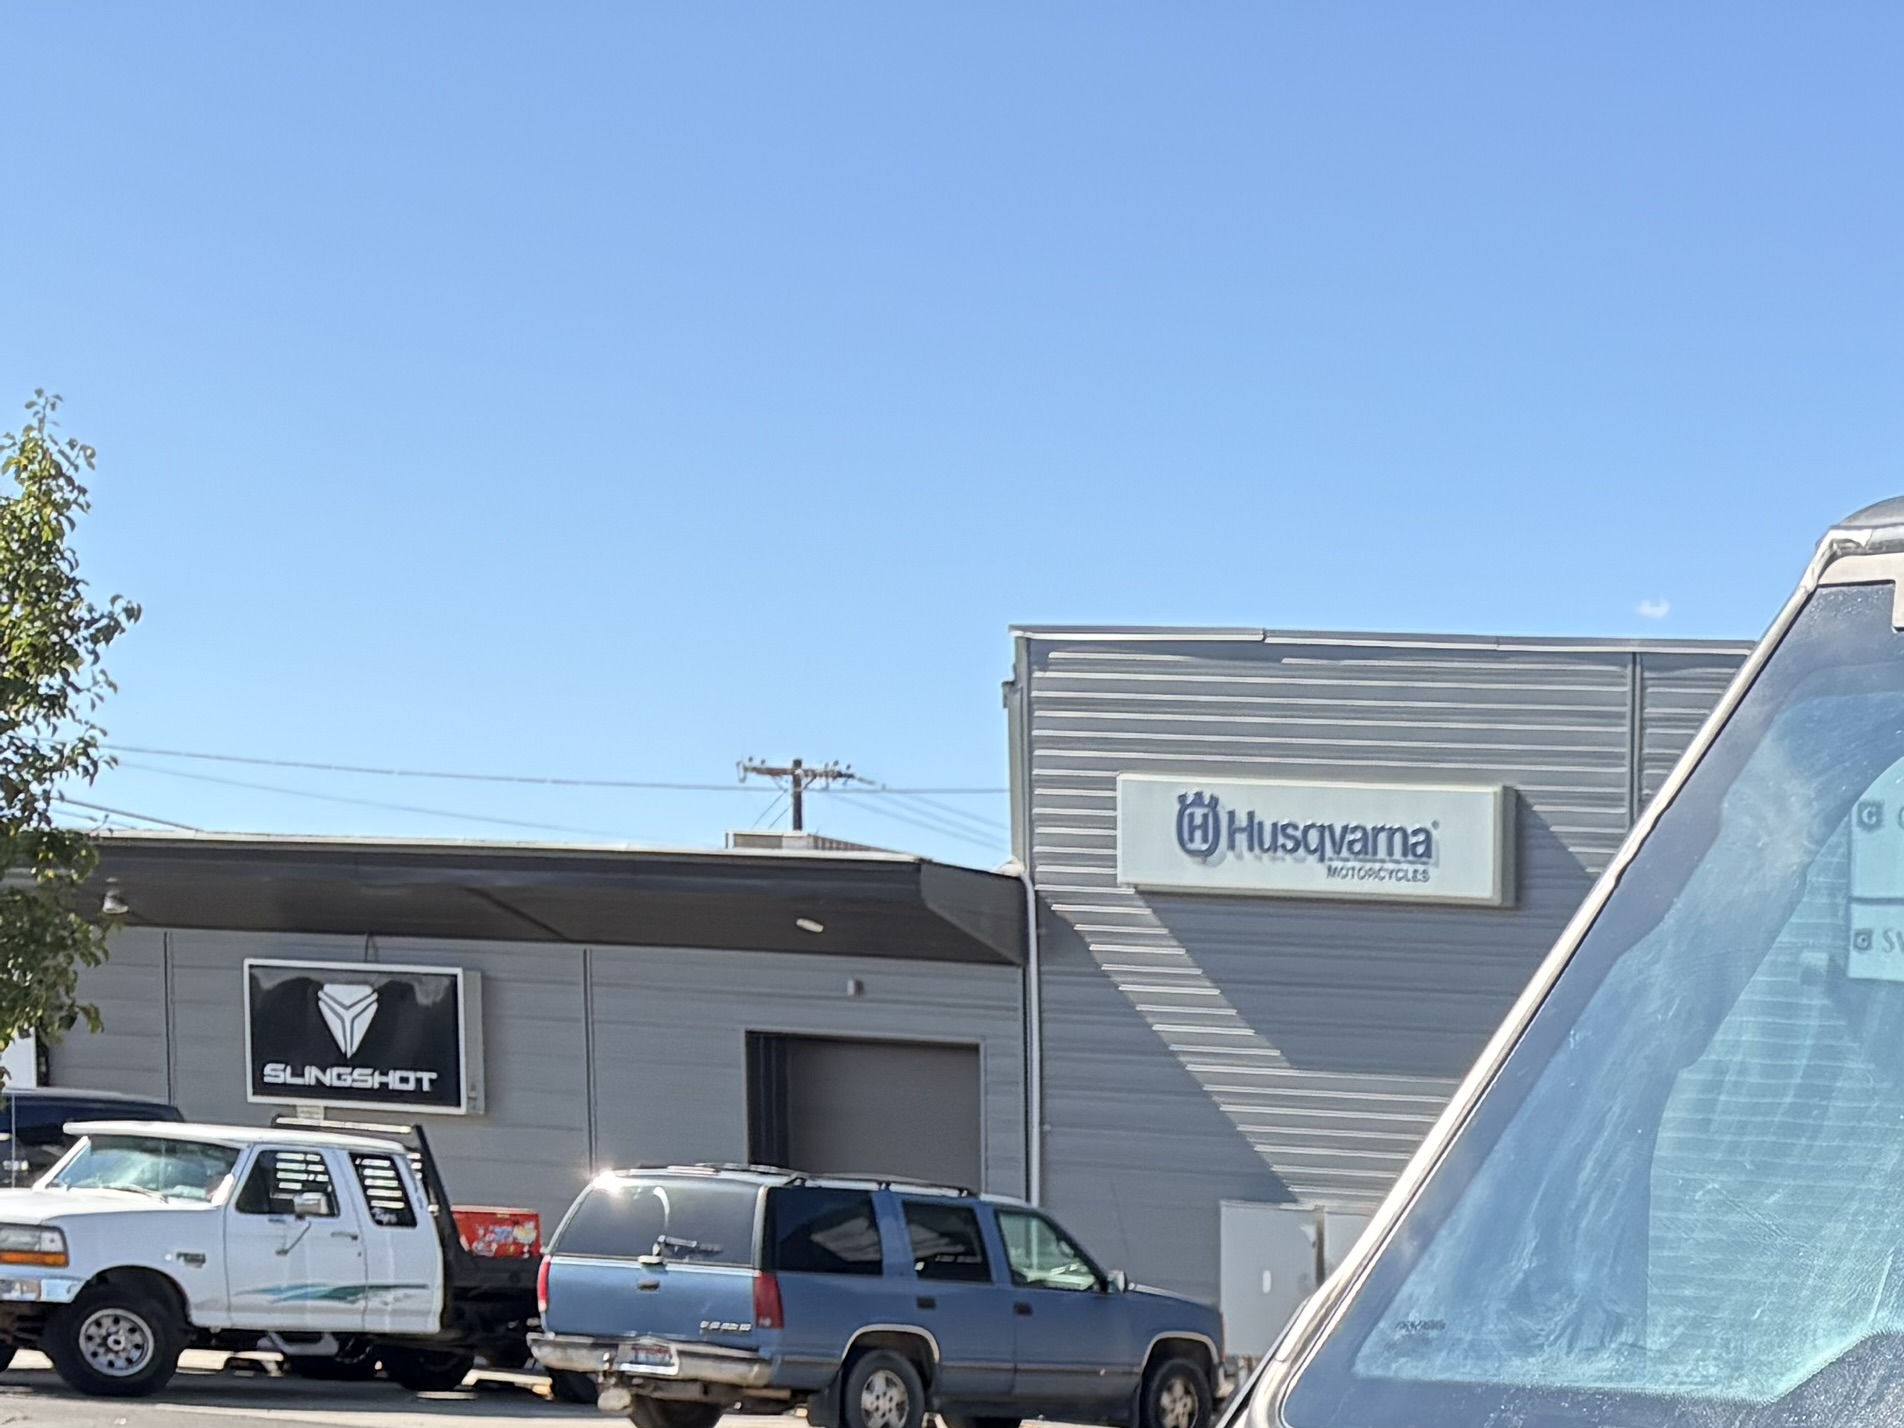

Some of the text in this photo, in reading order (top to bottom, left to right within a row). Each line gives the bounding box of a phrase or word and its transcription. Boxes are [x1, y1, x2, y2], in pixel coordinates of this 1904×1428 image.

[1226, 809, 1433, 863] Husqvarna
[1325, 863, 1431, 883] MOTORCYCLES
[263, 1061, 438, 1092] SLINGSHOT
